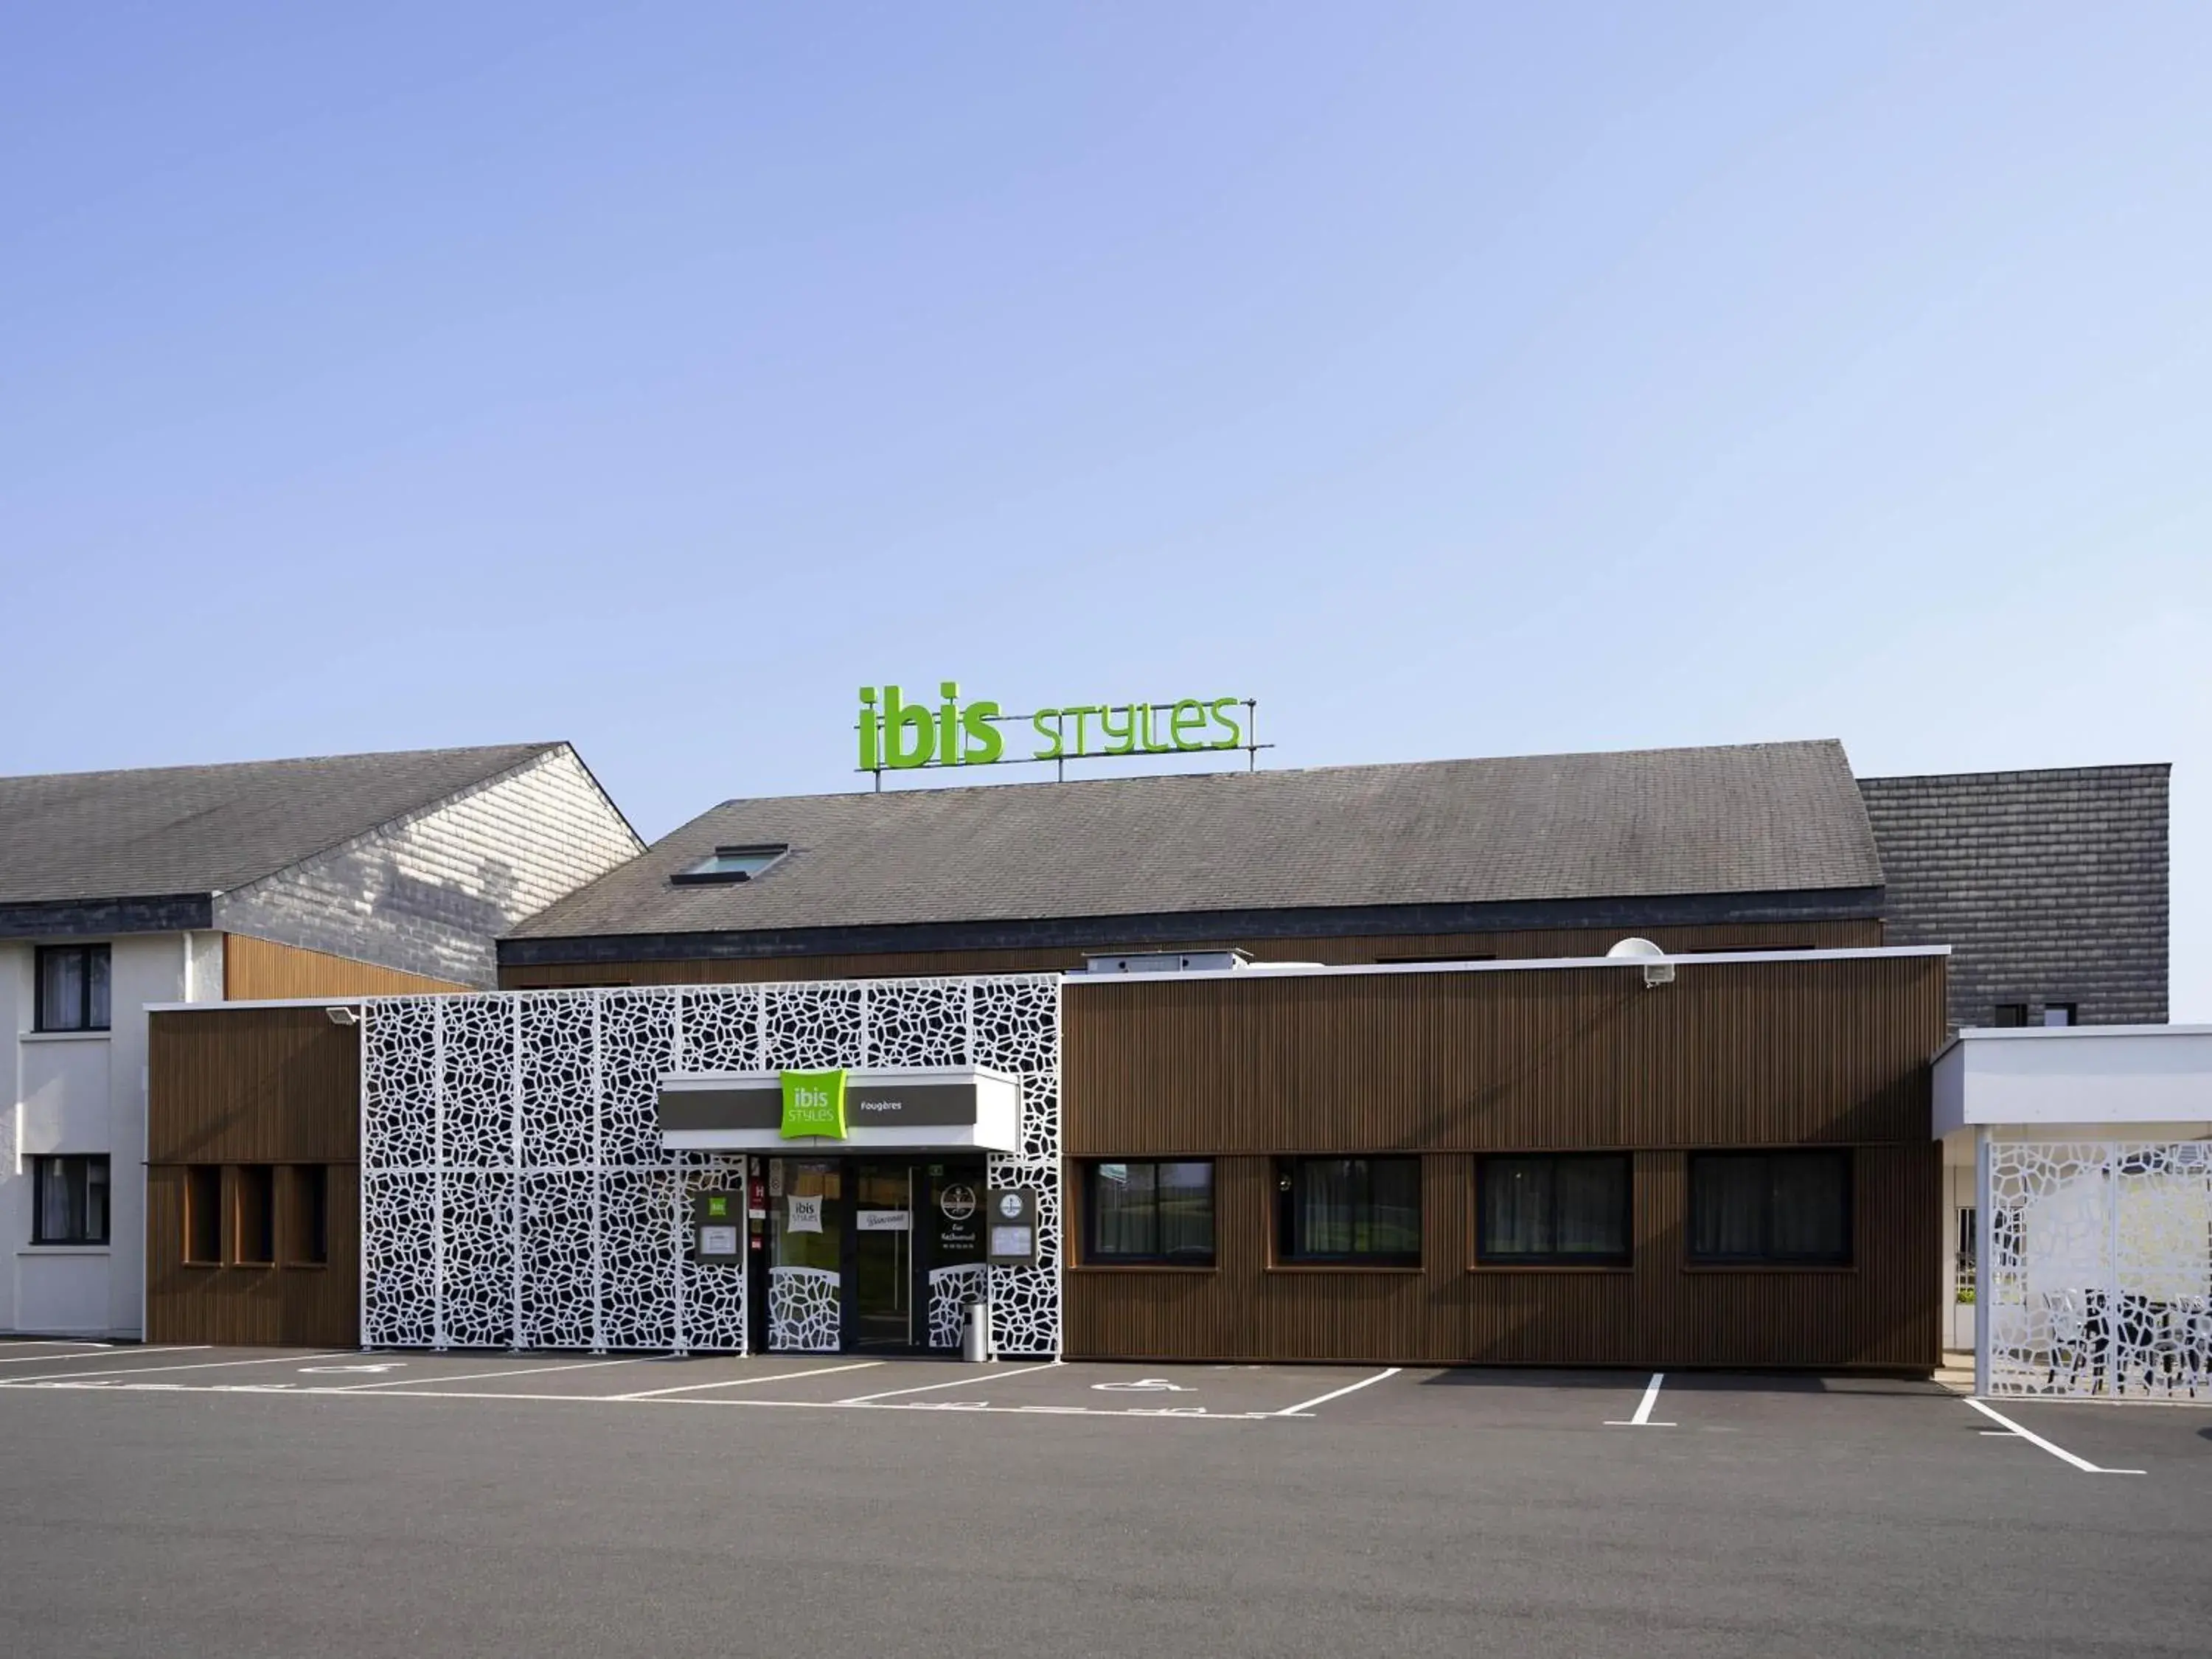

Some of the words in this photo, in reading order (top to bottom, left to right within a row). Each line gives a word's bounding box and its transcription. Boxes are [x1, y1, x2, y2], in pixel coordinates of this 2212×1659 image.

[859, 681, 1004, 771] ibis
[793, 1086, 829, 1107] ibis
[796, 1202, 815, 1214] ibis
